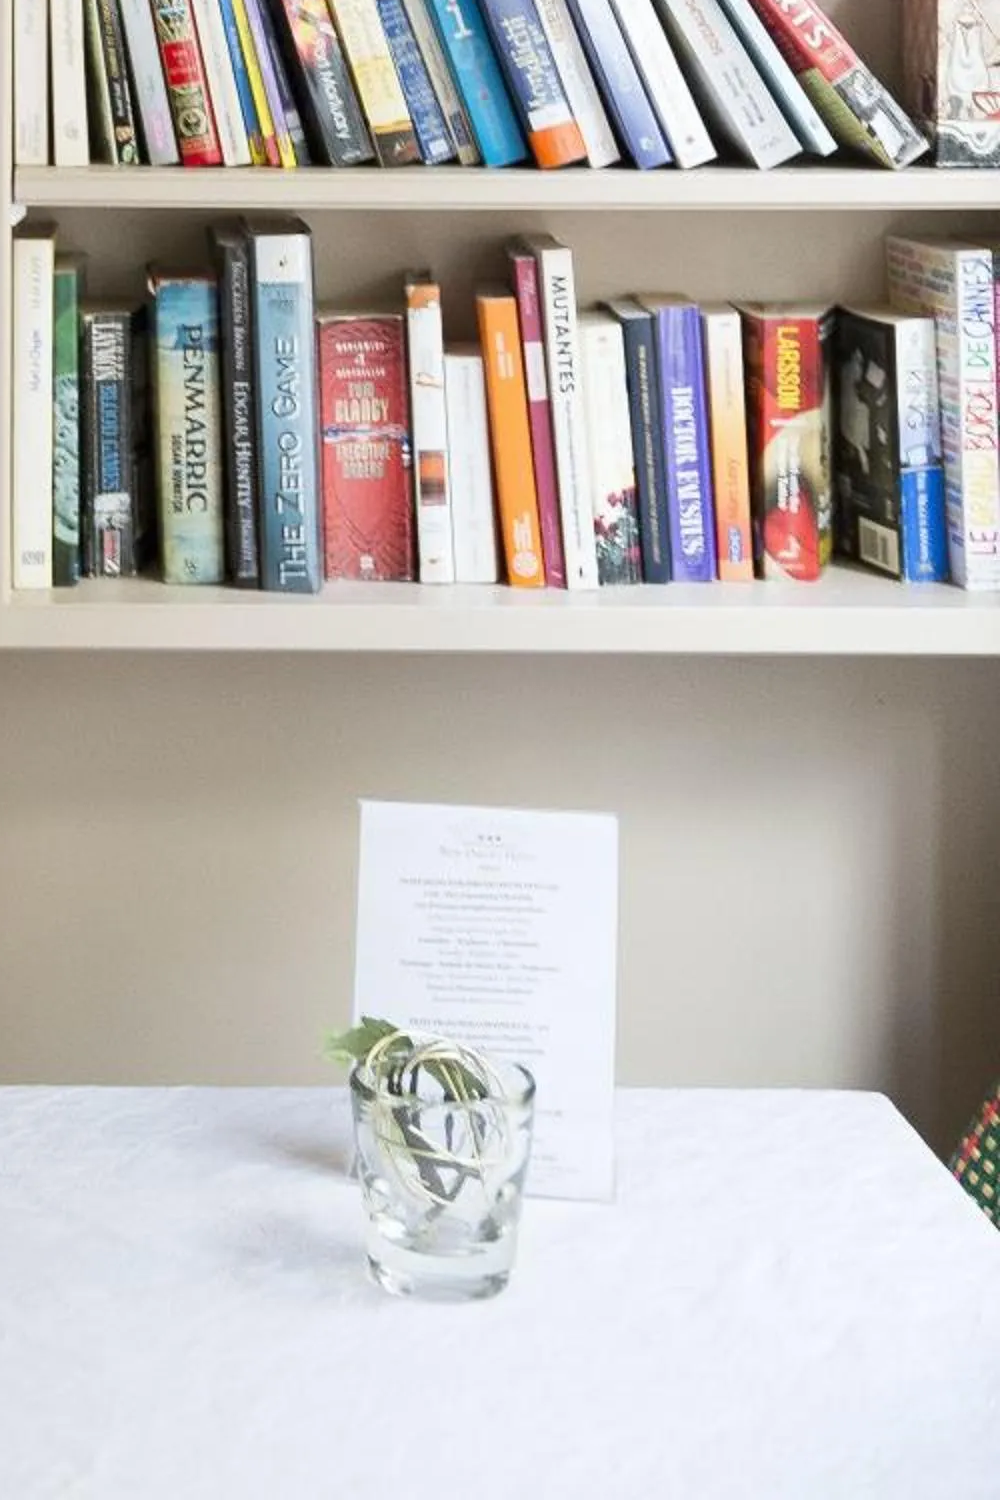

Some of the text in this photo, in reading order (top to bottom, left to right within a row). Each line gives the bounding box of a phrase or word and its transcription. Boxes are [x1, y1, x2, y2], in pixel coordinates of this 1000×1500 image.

[551, 275, 576, 394] MUTANTES
[776, 326, 801, 409] LARSSON
[966, 344, 990, 367] DE
[182, 323, 208, 513] PENMARRIC
[272, 336, 307, 584] THE ZERO GAME
[234, 441, 253, 510] HUNTLY
[671, 386, 705, 556] DOCTOR FAUSTUS
[969, 532, 997, 555] LE
